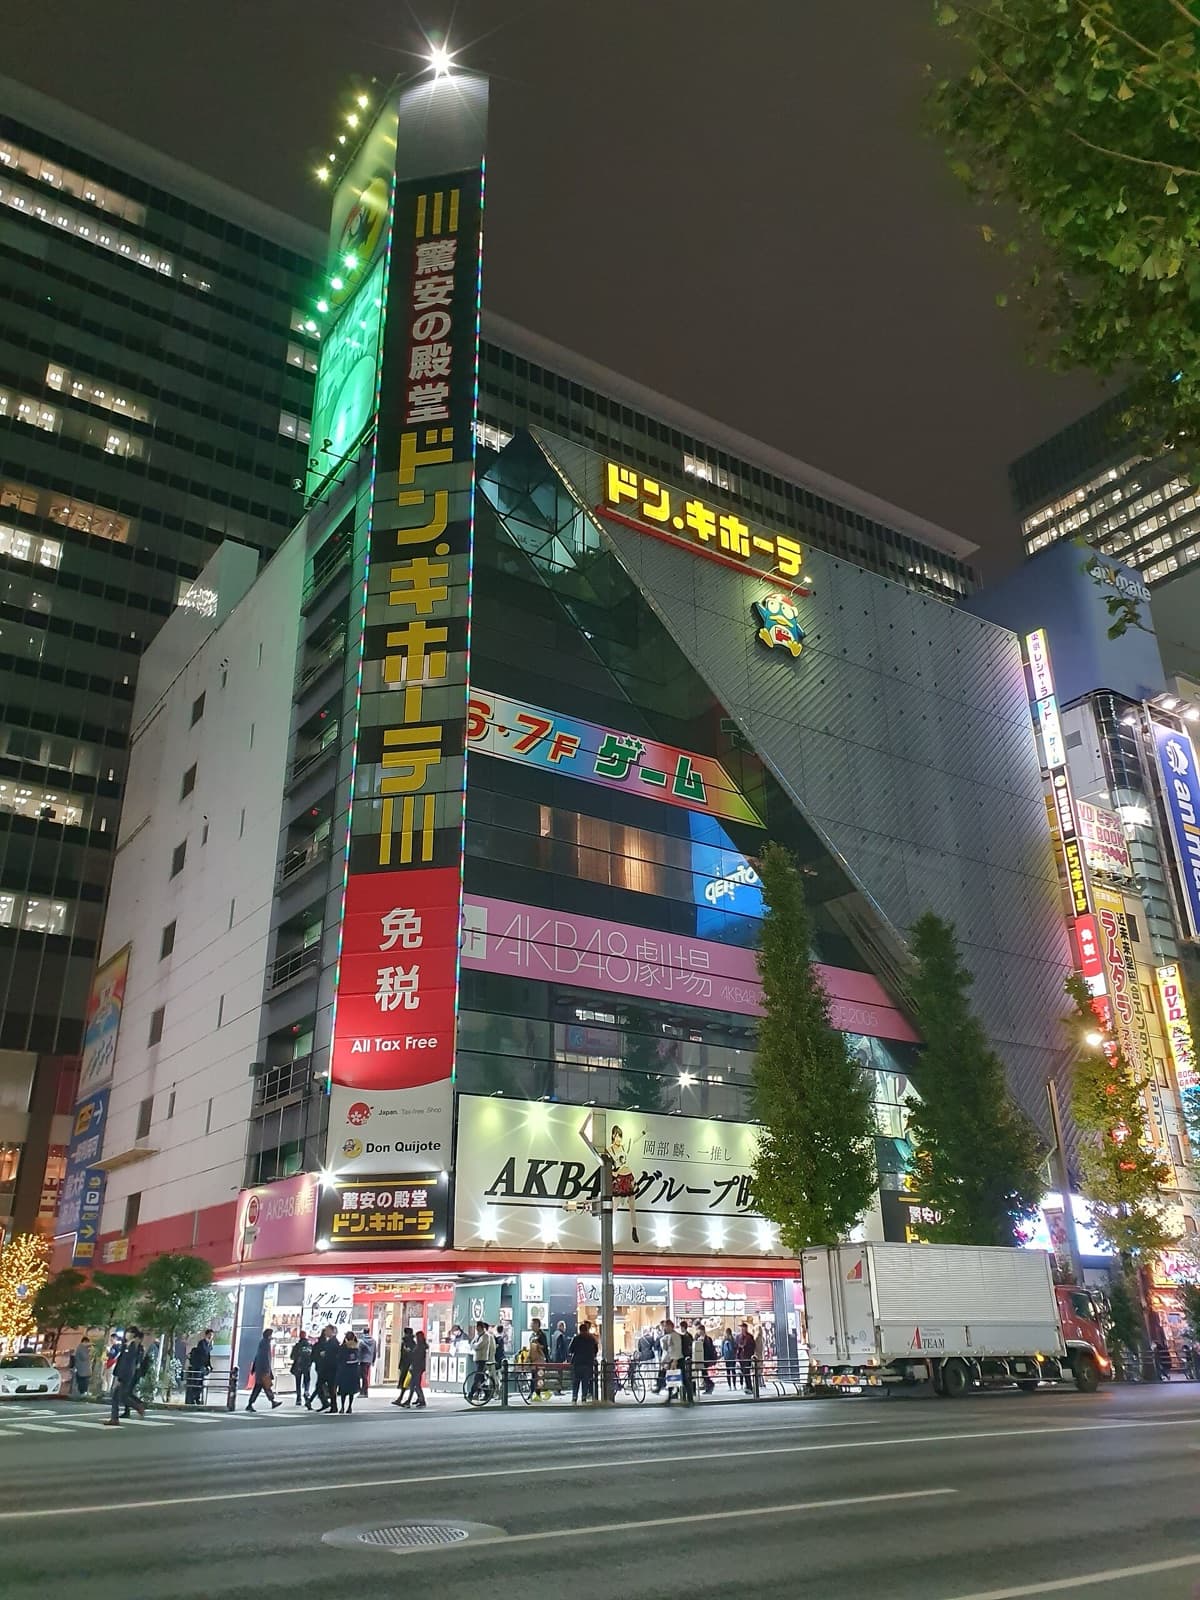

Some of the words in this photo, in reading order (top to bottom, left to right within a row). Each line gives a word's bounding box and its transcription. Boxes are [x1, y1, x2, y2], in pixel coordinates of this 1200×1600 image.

[406, 240, 457, 425] 驚安の殿堂
[592, 732, 708, 805] ゲーム
[374, 906, 424, 1013] 免税
[351, 1037, 371, 1054] All
[374, 1037, 401, 1052] Tax
[405, 1035, 438, 1050] Free
[366, 1142, 390, 1153] Don
[395, 1140, 441, 1154] Quijote
[342, 1189, 428, 1210] 驚安の殿堂
